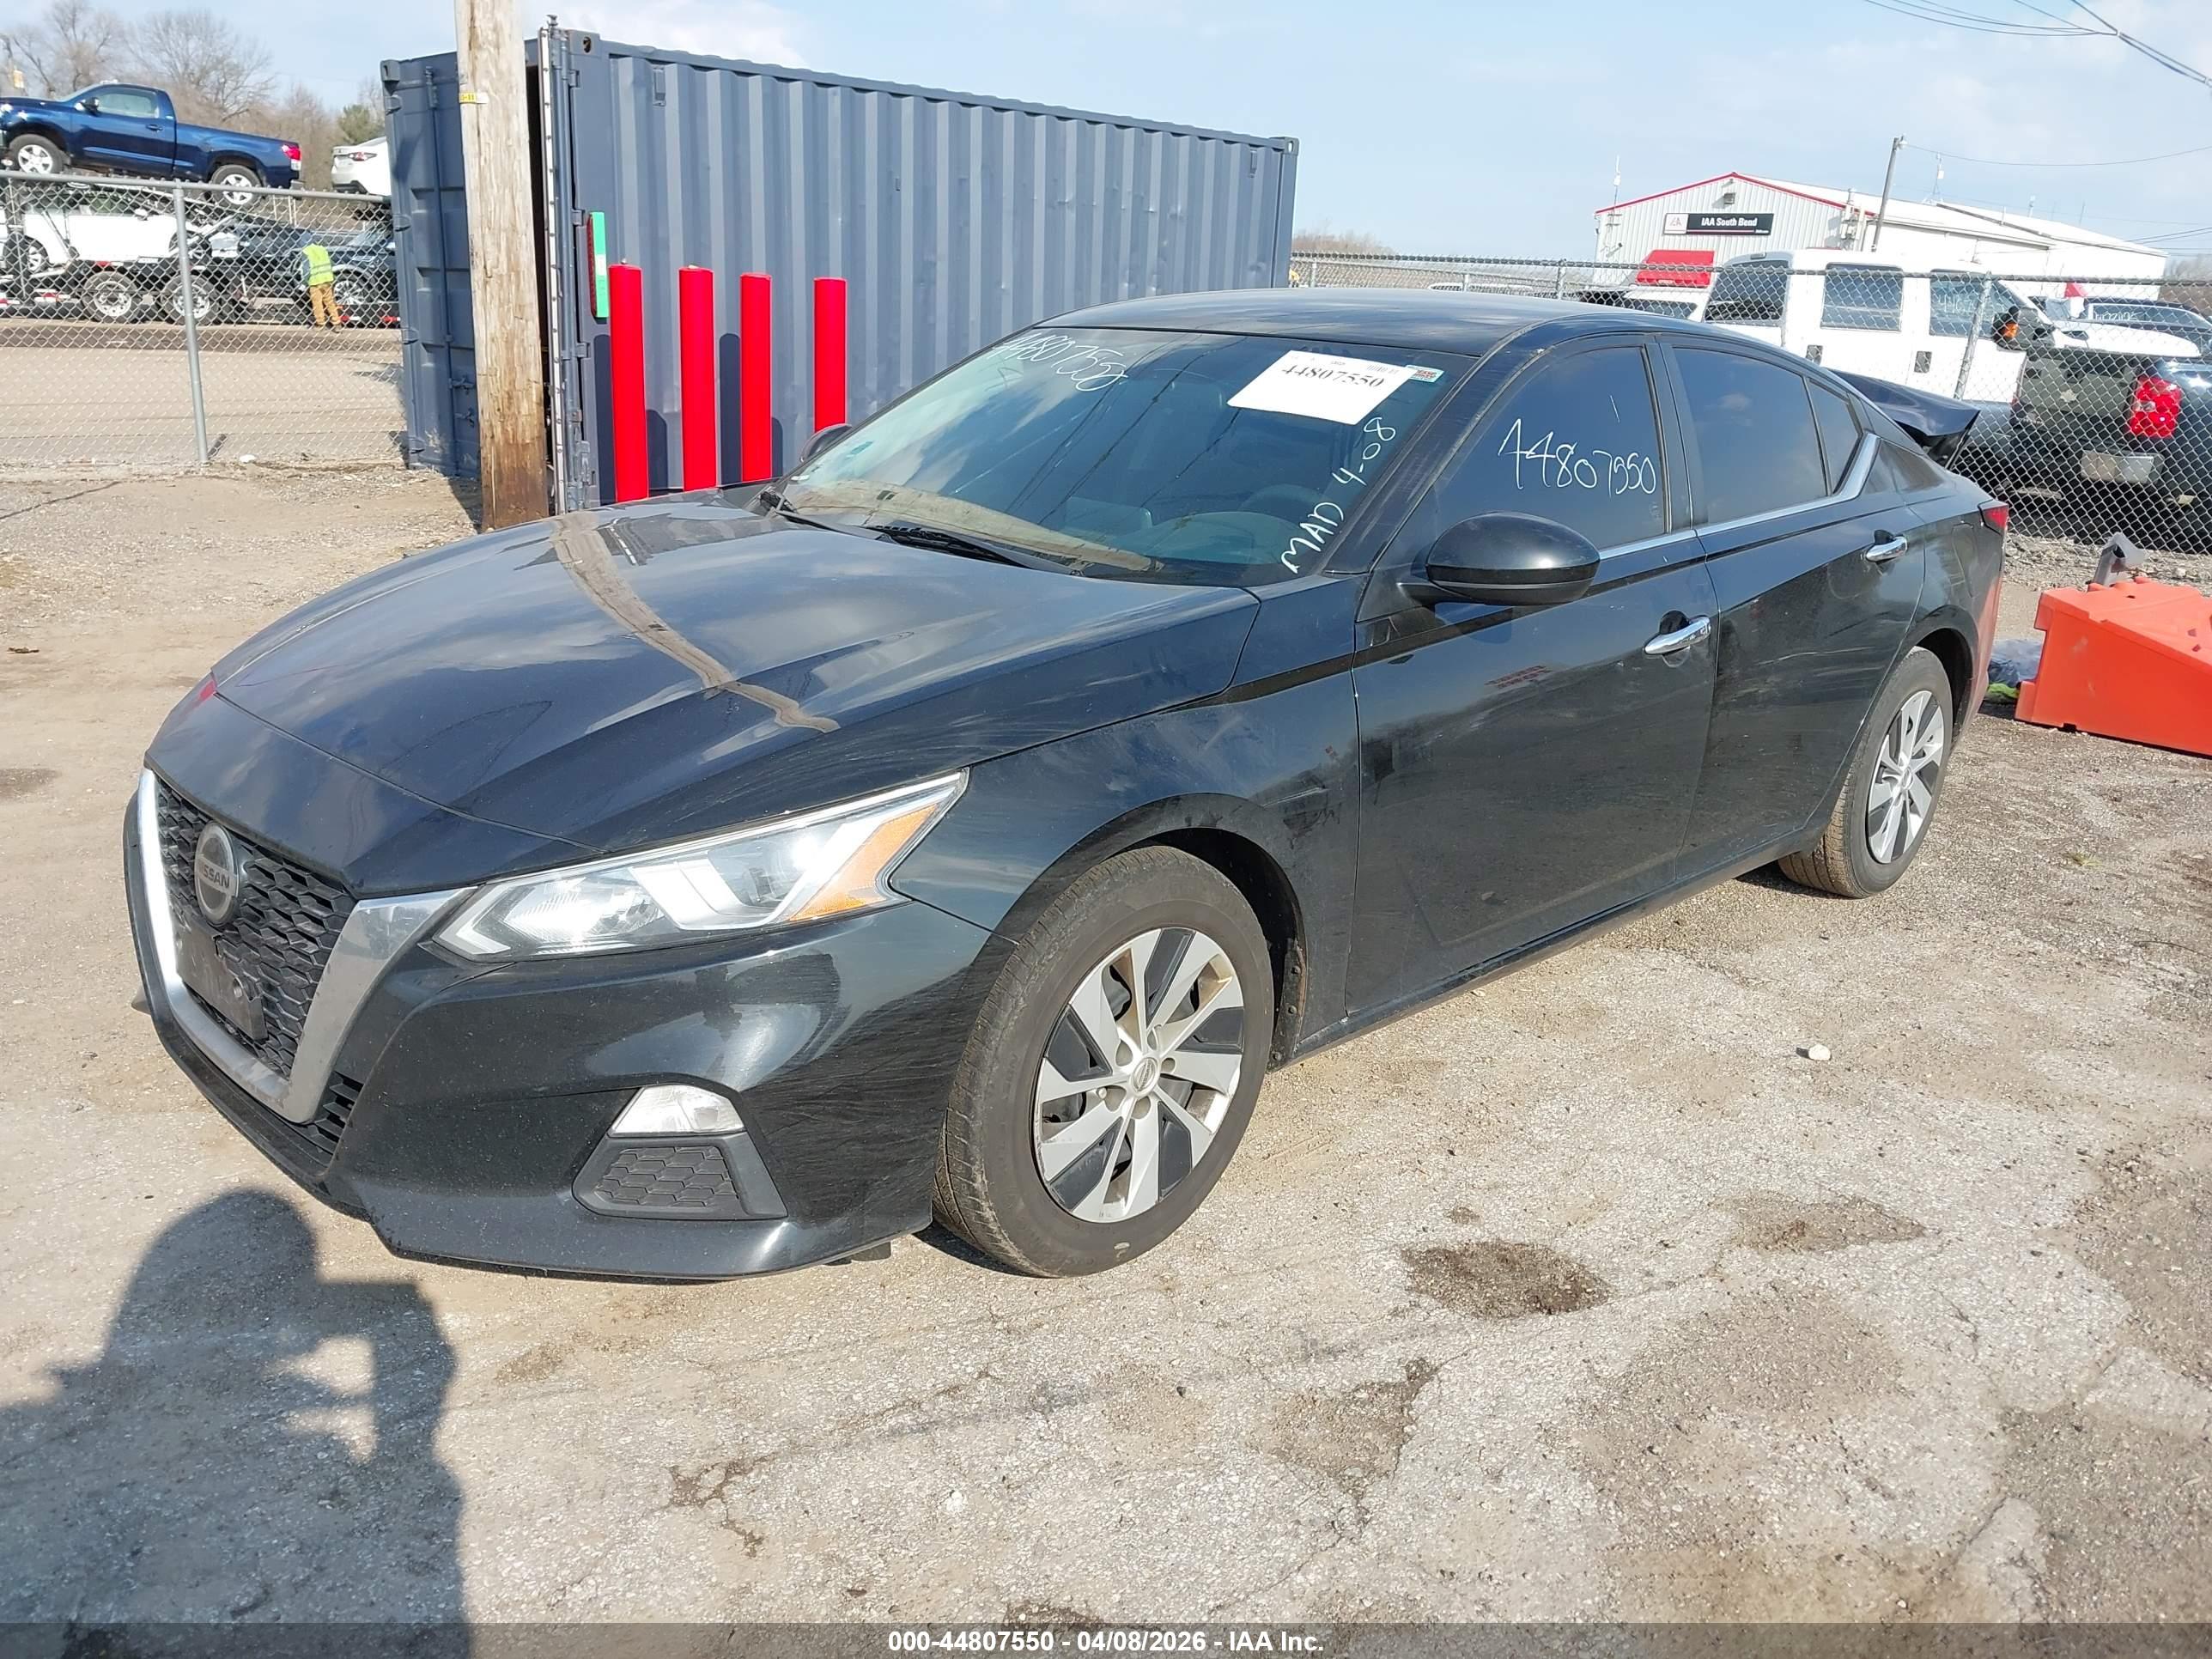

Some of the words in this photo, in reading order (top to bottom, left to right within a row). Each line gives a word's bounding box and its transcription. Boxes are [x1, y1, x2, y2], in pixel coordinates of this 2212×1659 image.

[1701, 217, 1715, 226] IAA
[1716, 217, 1736, 227] South
[1737, 217, 1758, 227] Bend
[1282, 364, 1385, 387] 44807550
